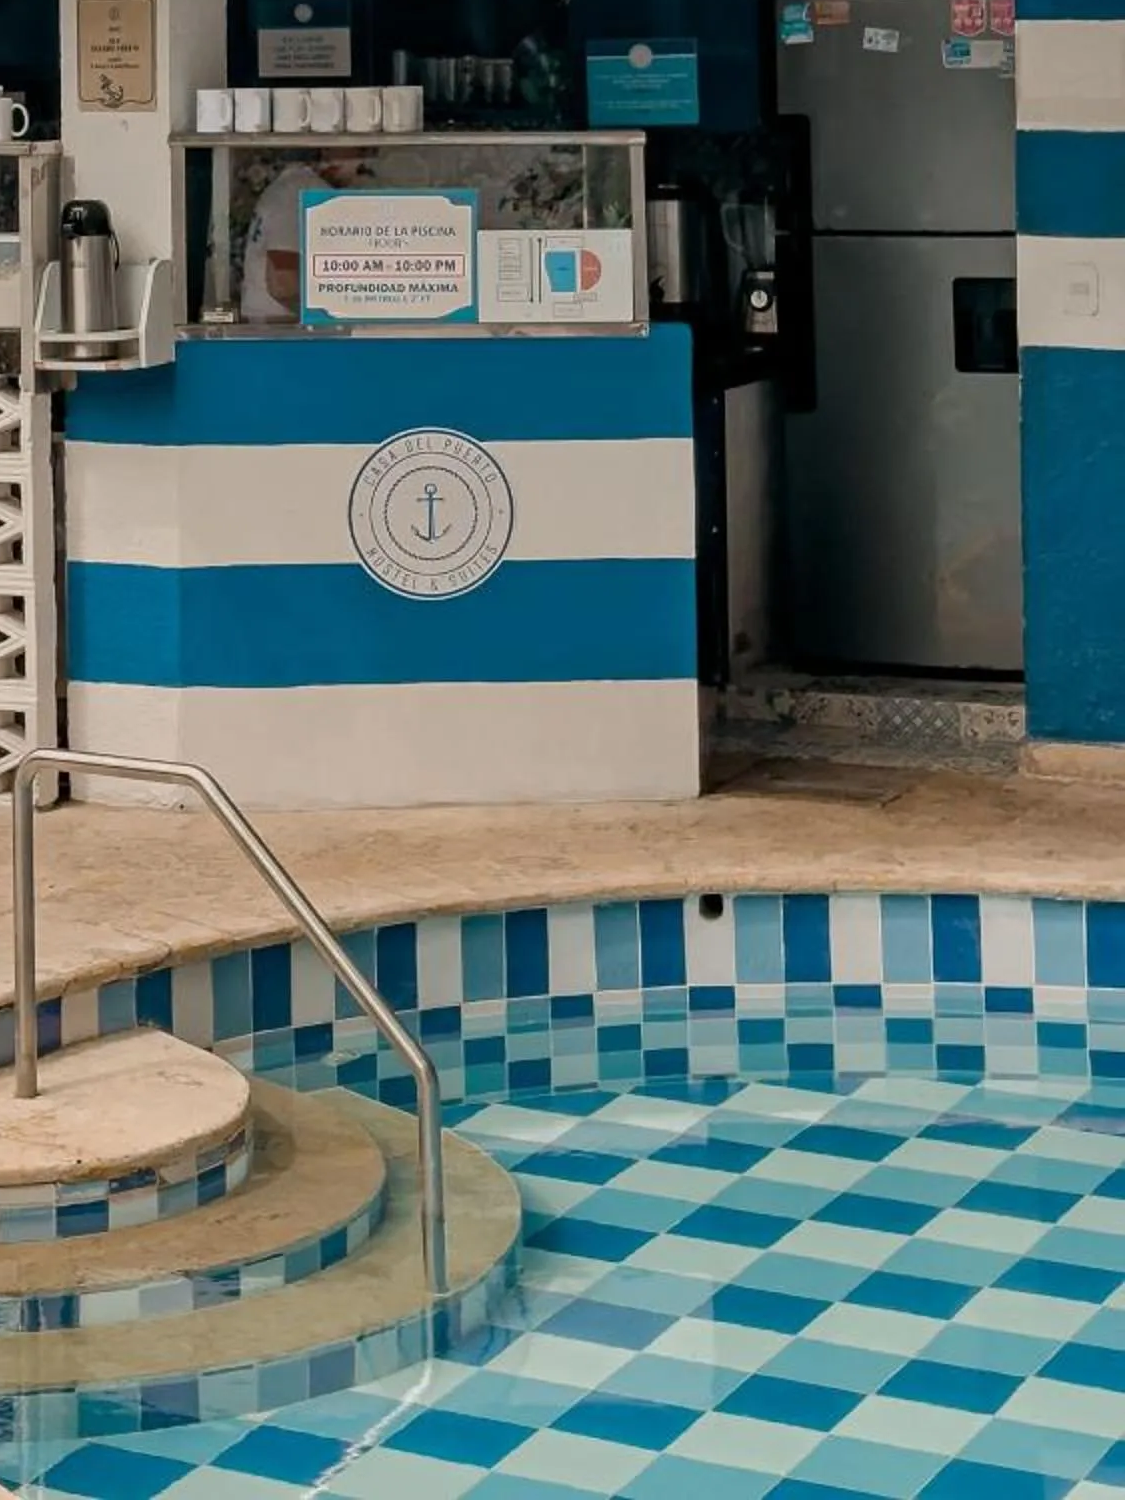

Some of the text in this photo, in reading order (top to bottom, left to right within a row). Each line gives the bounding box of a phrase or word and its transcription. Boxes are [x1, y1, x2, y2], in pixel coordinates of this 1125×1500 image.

[320, 226, 457, 237] HORARIO DE LA PISCINA
[322, 259, 360, 272] 10:00
[362, 259, 384, 272] AM
[394, 259, 432, 272] 10:00
[435, 259, 456, 272] PM
[318, 283, 406, 293] PROFUNDIDAD
[363, 437, 497, 486] CASA DEL PUERTO
[365, 547, 417, 591] HOSTEL
[448, 544, 498, 588] SUITES
